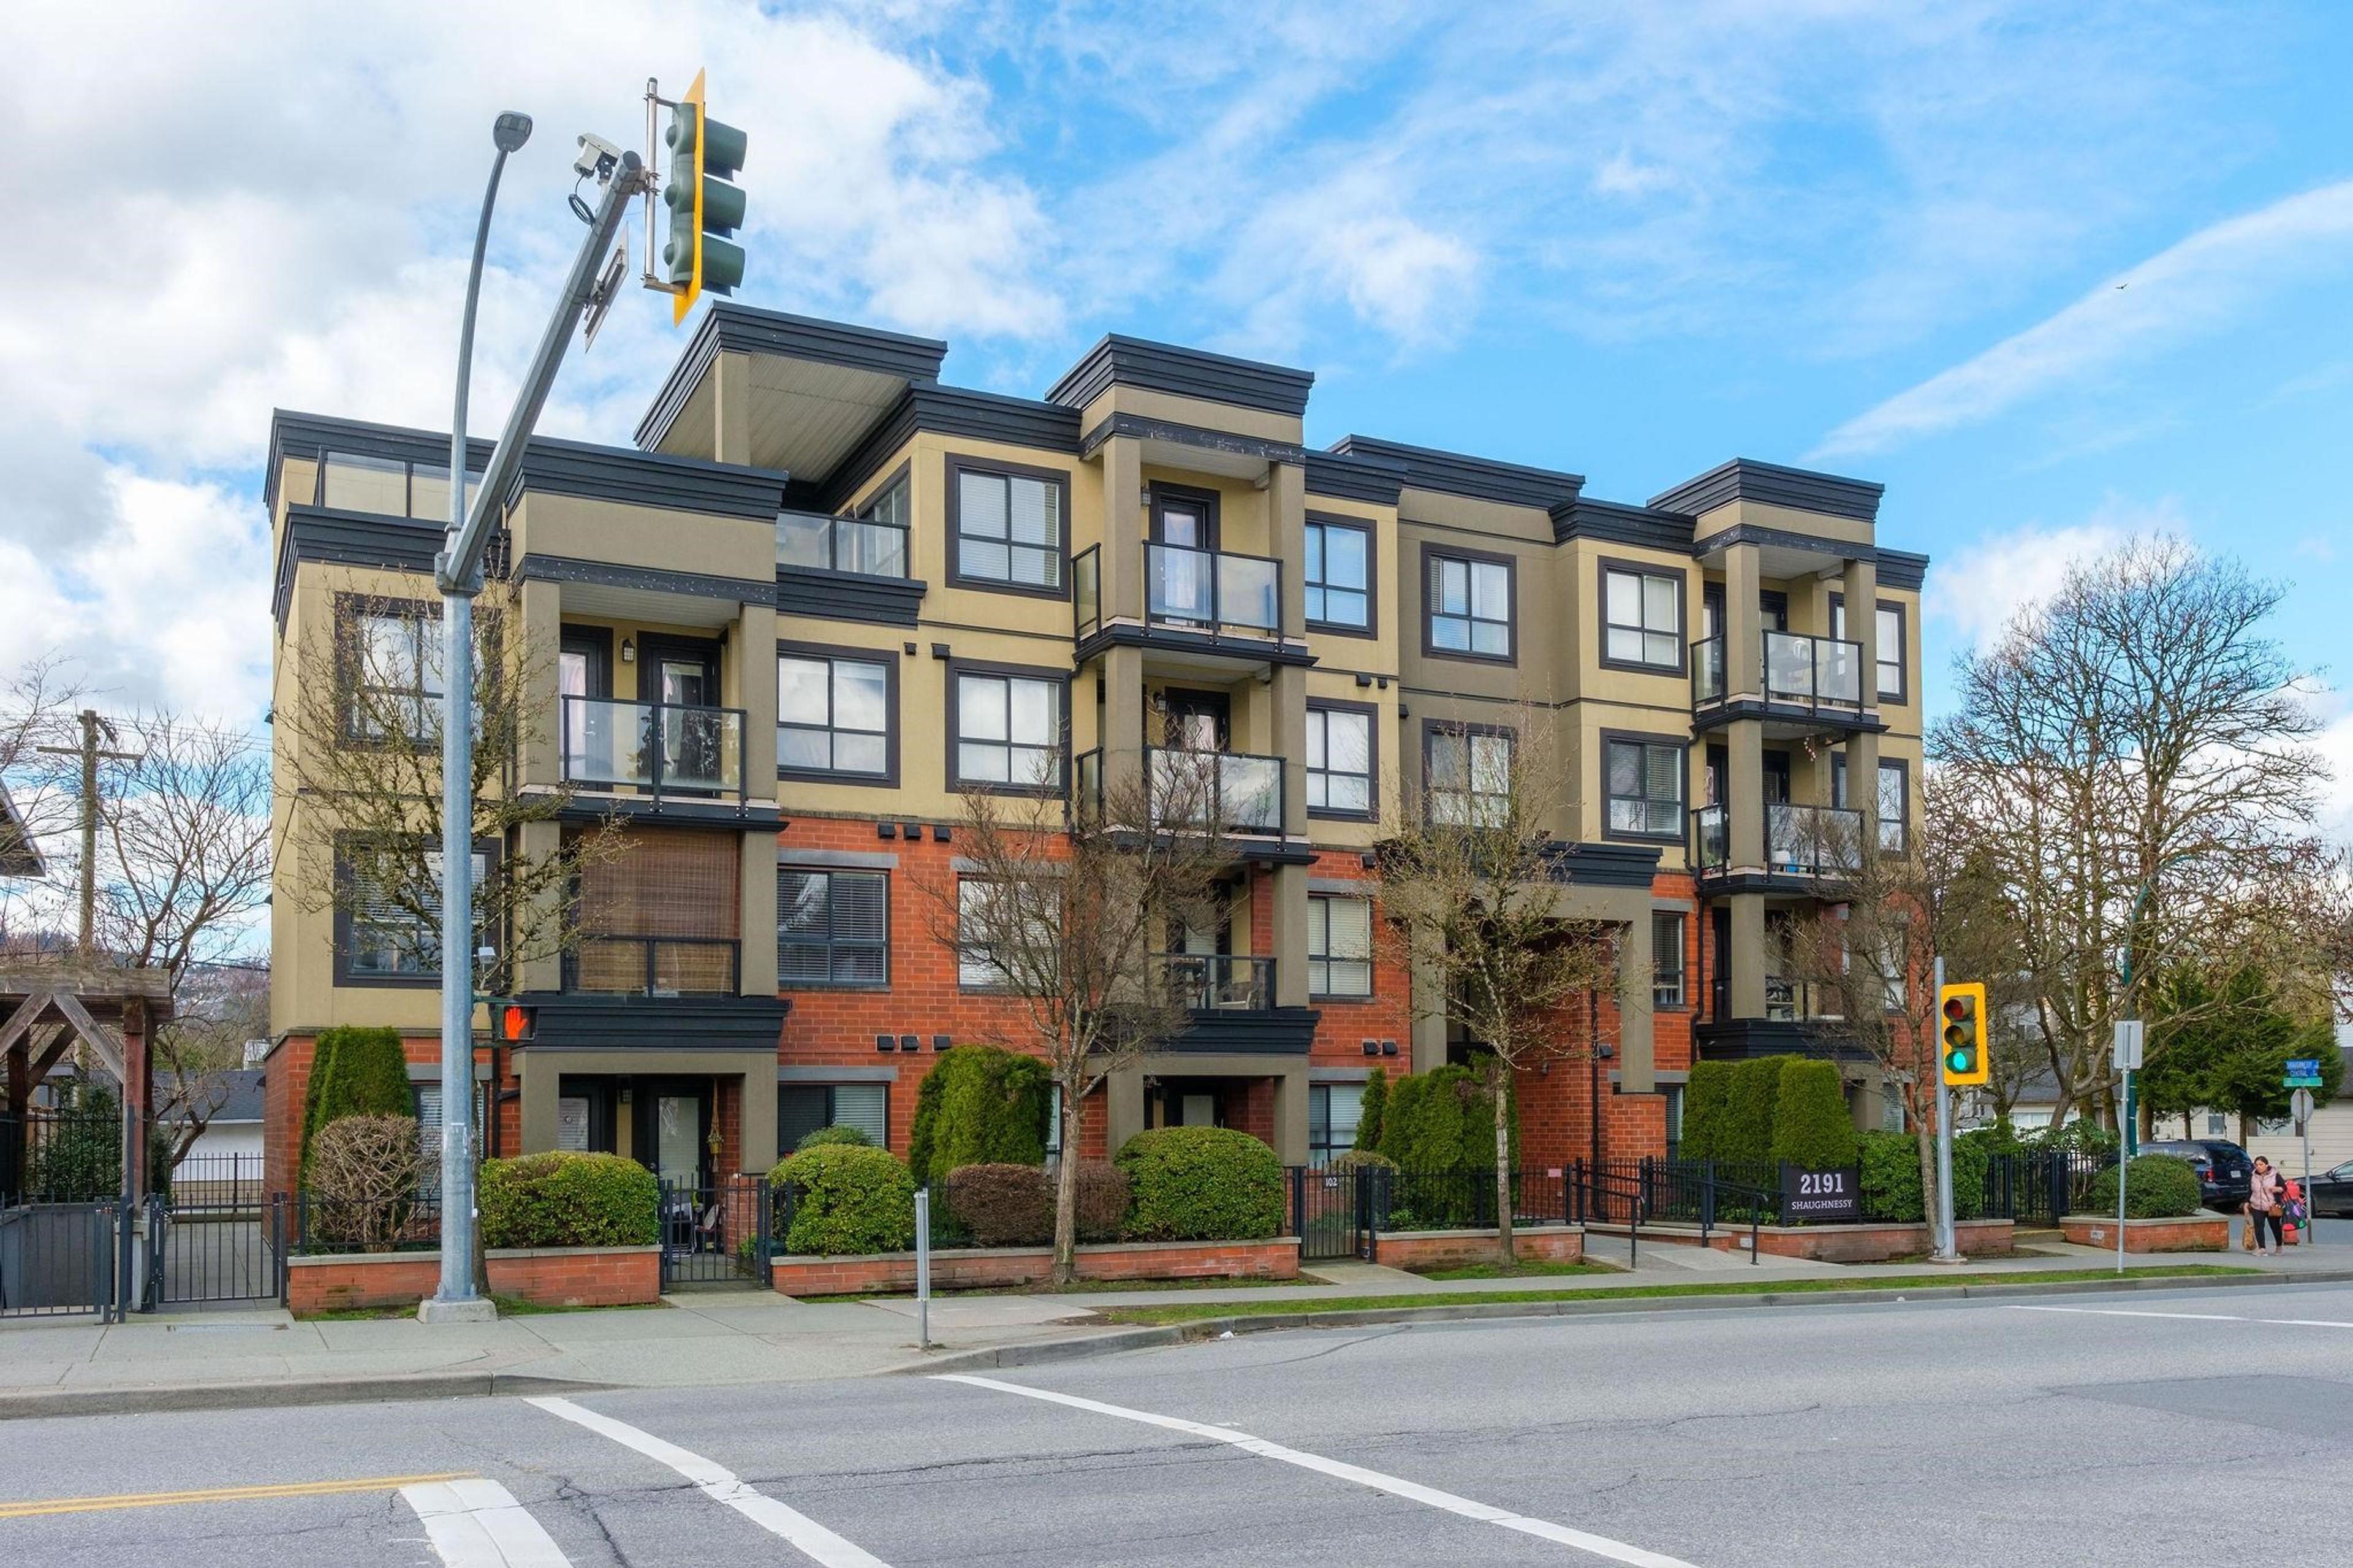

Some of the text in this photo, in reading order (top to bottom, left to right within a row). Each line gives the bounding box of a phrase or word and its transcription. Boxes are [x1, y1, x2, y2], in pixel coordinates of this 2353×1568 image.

[1326, 1177, 1338, 1186] 102
[1800, 1173, 1843, 1194] 2191
[1792, 1199, 1852, 1210] SHAUGHNESSY
